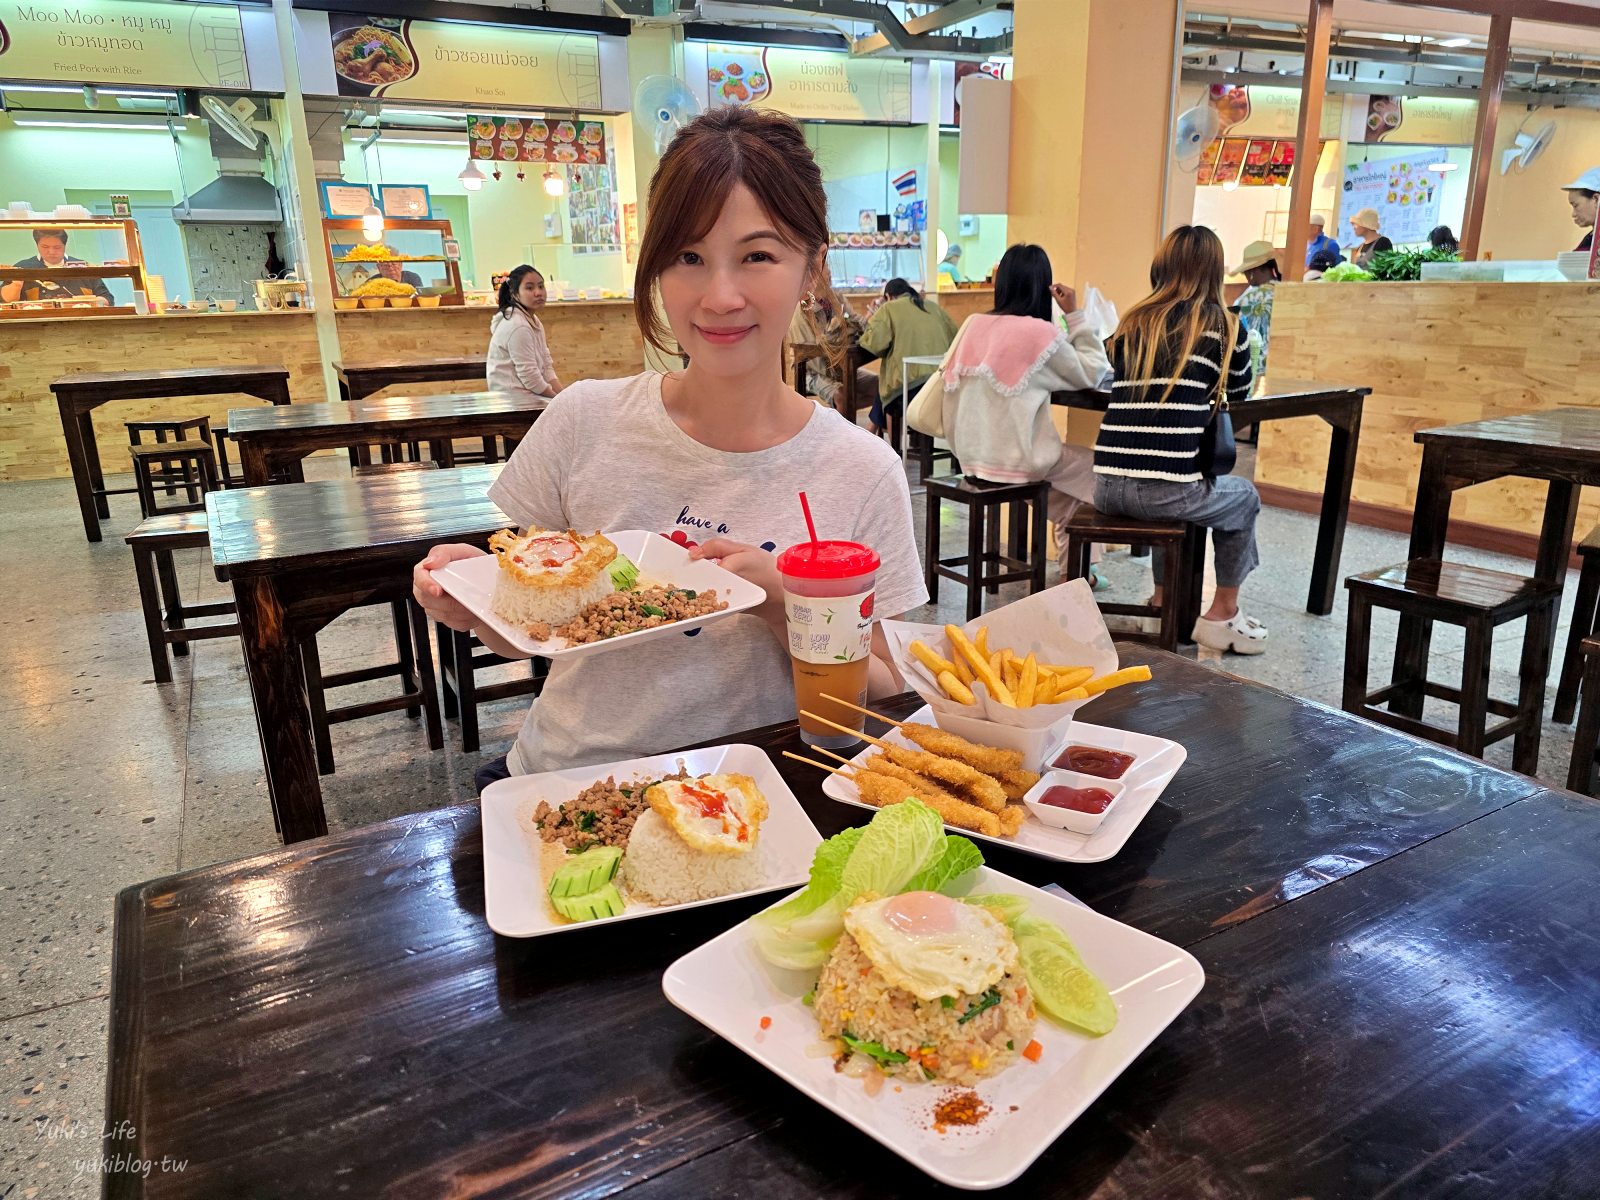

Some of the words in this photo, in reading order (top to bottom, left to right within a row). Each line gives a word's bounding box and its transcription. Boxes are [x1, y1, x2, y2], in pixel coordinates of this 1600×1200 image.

[17, 5, 59, 23] Moo
[64, 8, 104, 26] Moo
[121, 15, 144, 32] หมู
[150, 17, 172, 34] หมู
[57, 31, 144, 52] ข้าวหมูทอด
[435, 44, 539, 68] ข้าวซอยแม่จอย
[53, 62, 77, 72] Fried
[79, 64, 101, 73] Pork
[101, 65, 121, 74] with
[123, 66, 142, 75] Rice
[475, 87, 494, 96] Khao
[494, 88, 506, 97] Soi
[675, 505, 713, 530] have
[716, 521, 731, 534] a
[810, 632, 831, 643] LOW
[810, 641, 829, 651] FAT
